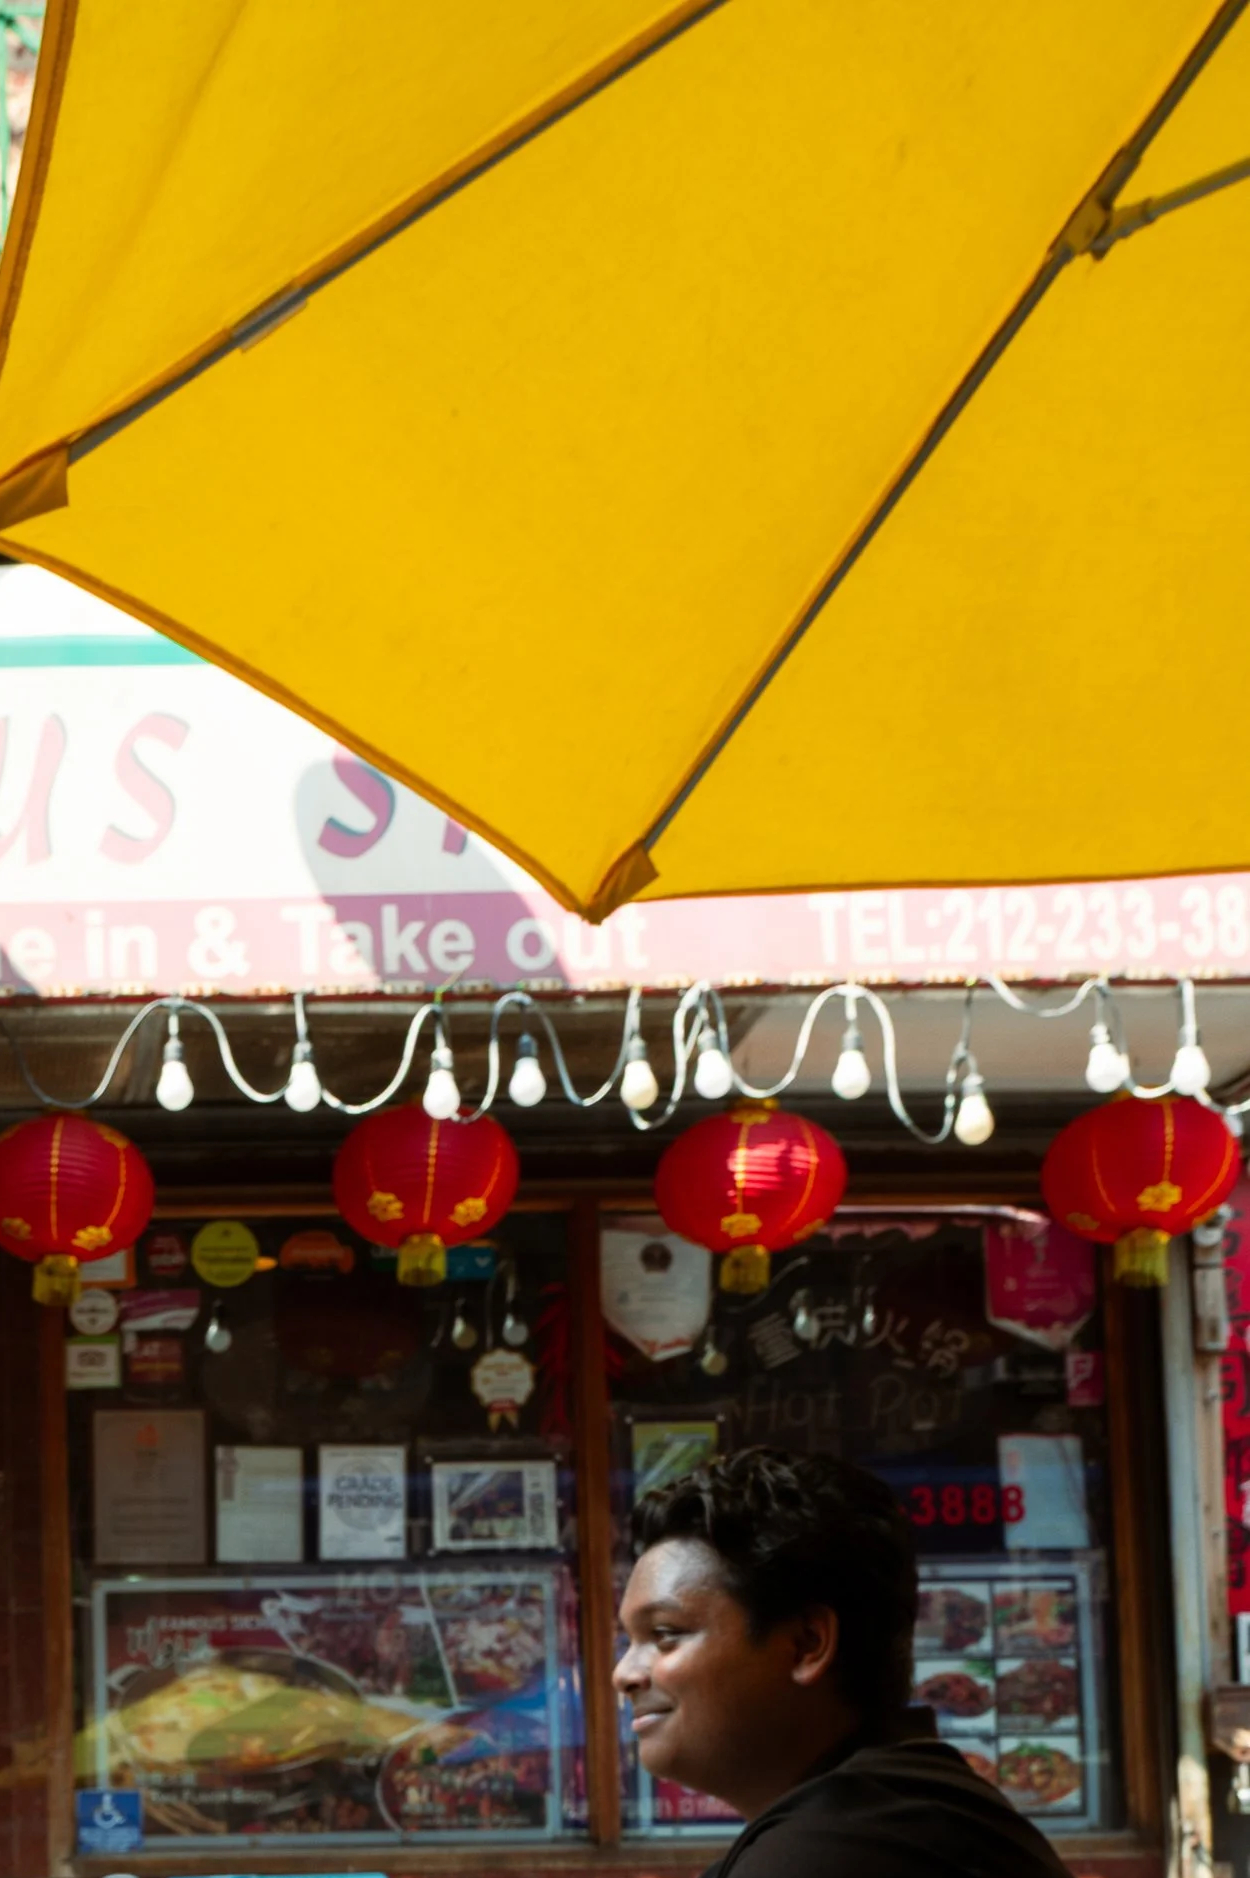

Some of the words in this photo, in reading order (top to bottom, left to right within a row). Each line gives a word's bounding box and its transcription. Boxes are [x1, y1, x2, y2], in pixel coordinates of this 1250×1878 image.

[316, 742, 469, 860] S
[85, 909, 168, 979] in
[188, 906, 250, 979] &
[281, 903, 475, 974] Take
[506, 902, 650, 972] out
